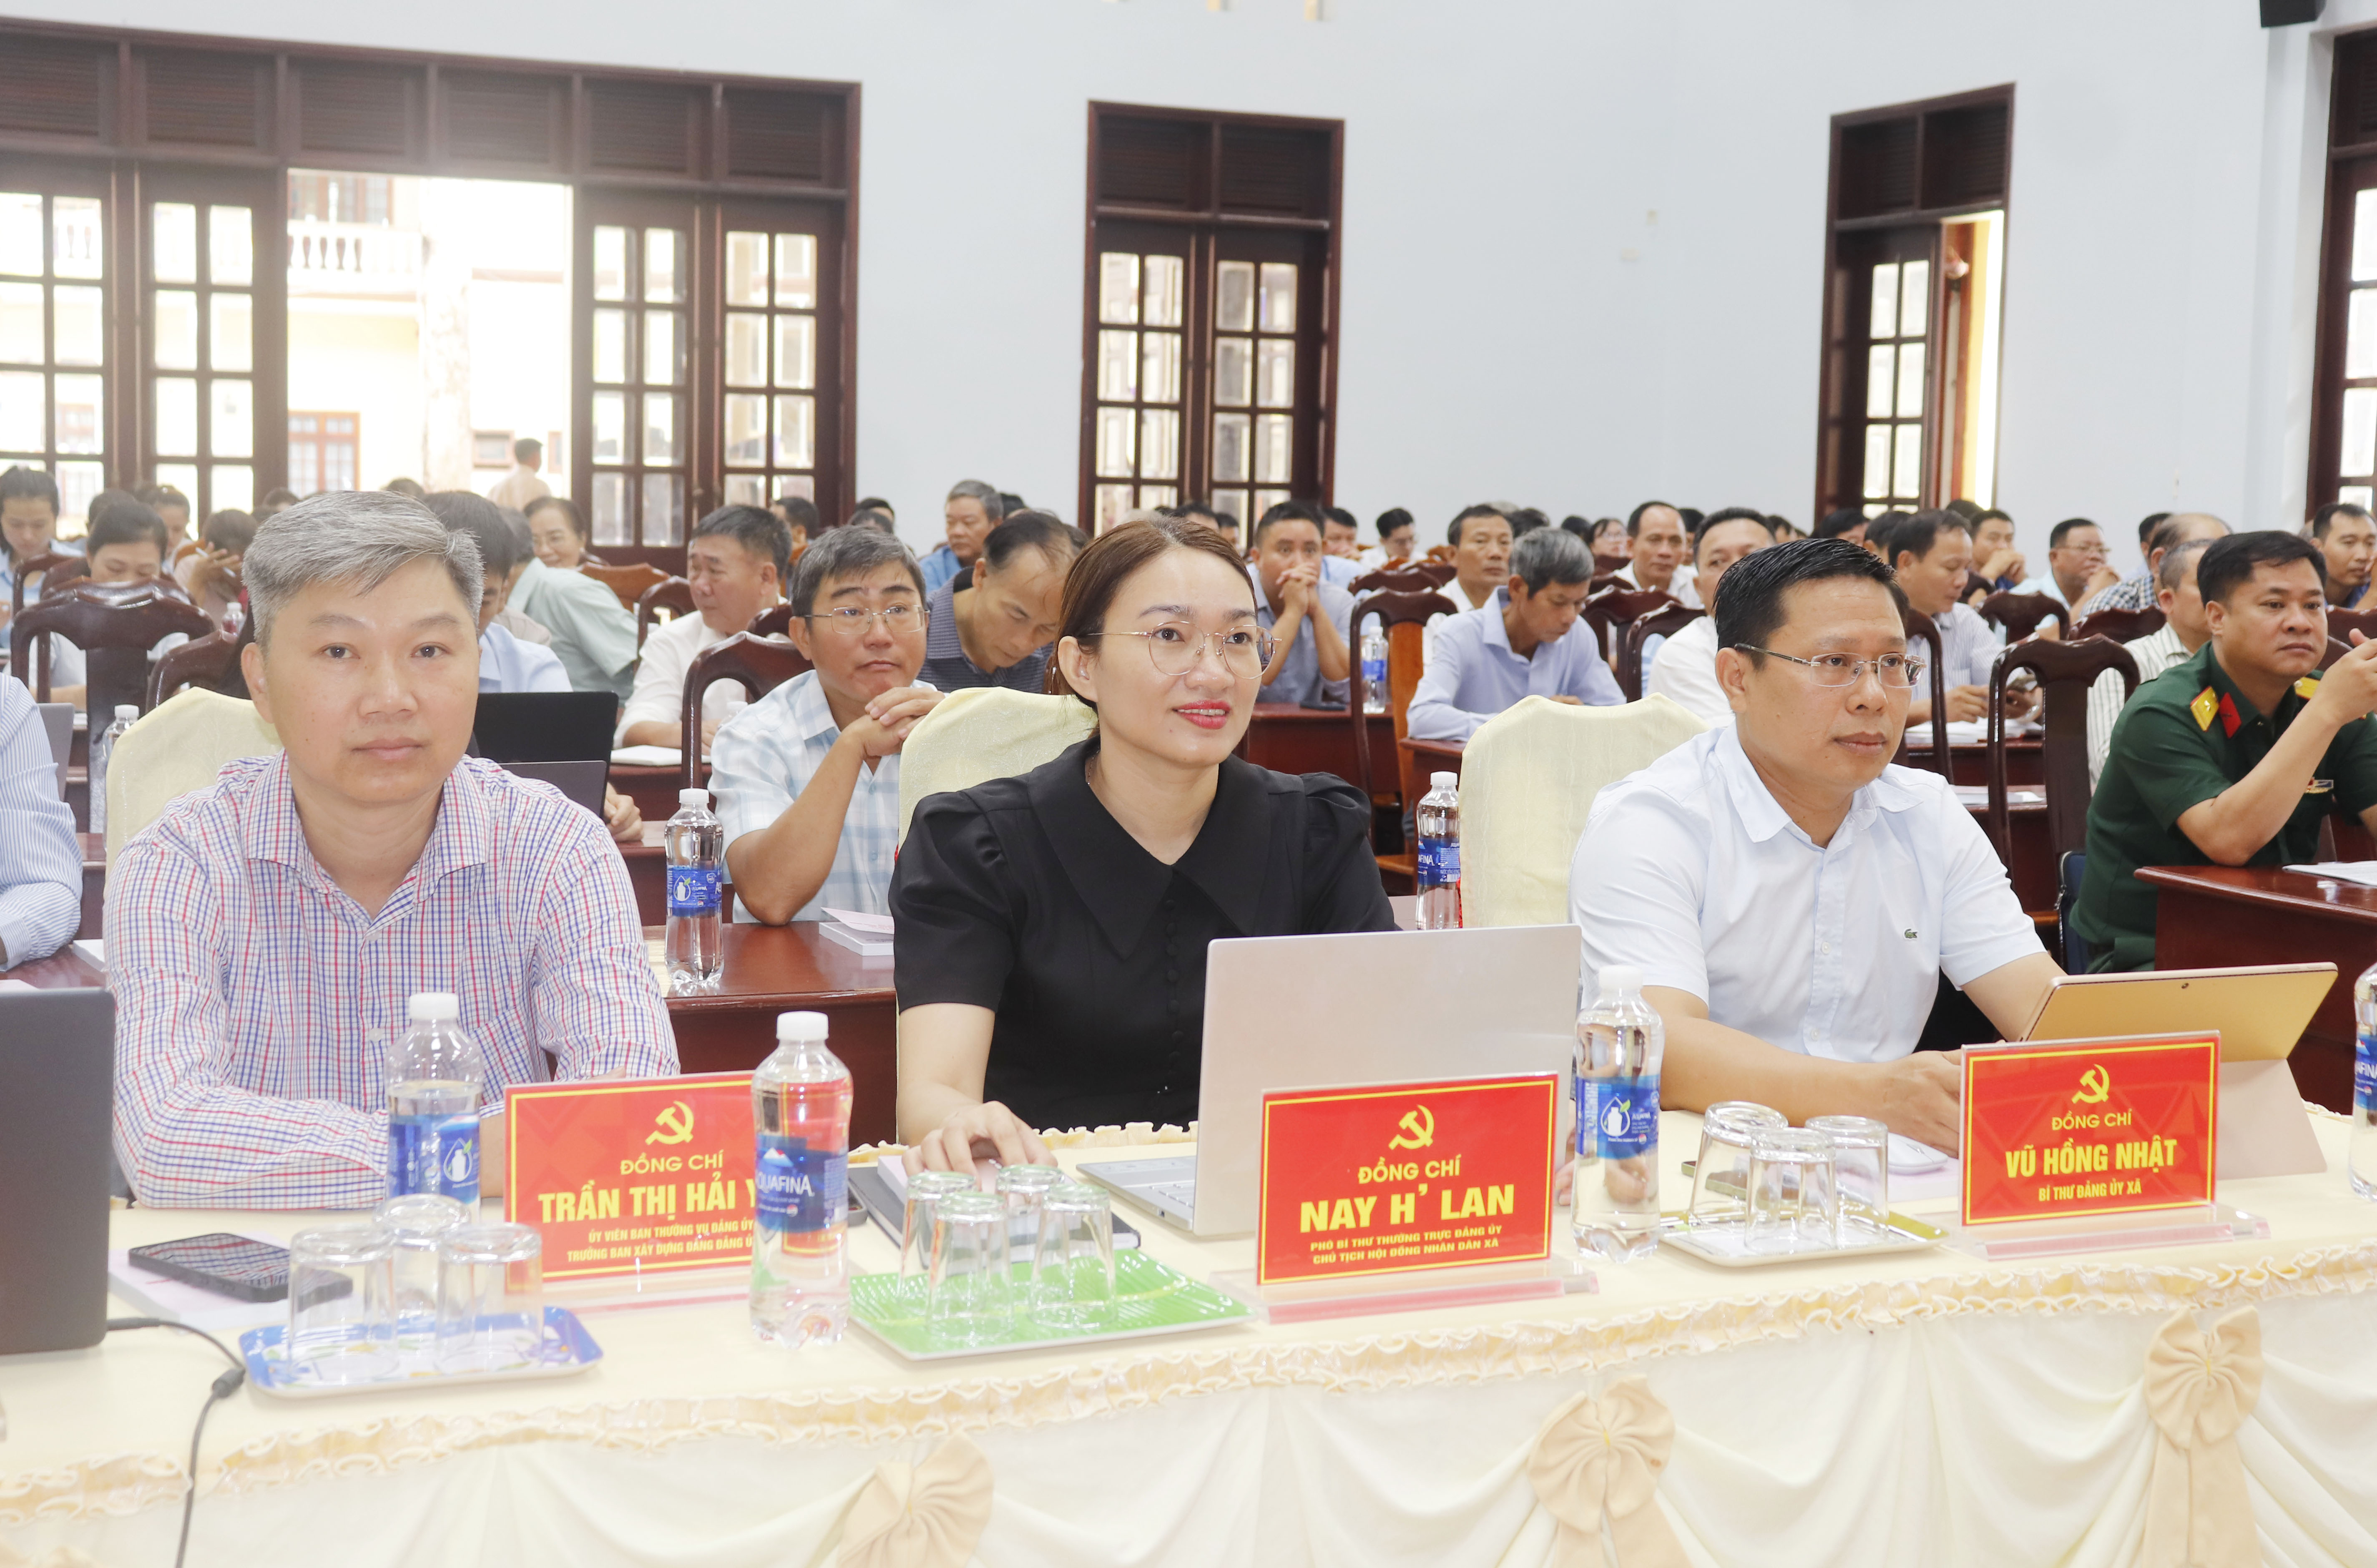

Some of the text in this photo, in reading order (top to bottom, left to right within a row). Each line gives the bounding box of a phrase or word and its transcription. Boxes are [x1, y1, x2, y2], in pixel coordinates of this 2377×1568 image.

[1418, 854, 1434, 866] AFINA
[2052, 1108, 2132, 1131] ĐỒNG CHÍ
[620, 1149, 724, 1175] ĐỒNG CHÍ
[2005, 1134, 2177, 1178] VŨ HỒNG NHẬT
[1358, 1153, 1461, 1184] ĐỒNG CHÍ
[757, 1171, 813, 1197] QUAFINA
[2039, 1178, 2142, 1201] BÍ THƯ ĐẢNG ỦY XÃ
[538, 1179, 620, 1223] TRẦN
[629, 1184, 676, 1221] THỊ
[686, 1171, 735, 1212] HẢI
[1300, 1195, 1377, 1233] NAY
[1441, 1184, 1514, 1220] LAN
[605, 1228, 628, 1241] VIÊN
[630, 1227, 652, 1240] BAN
[1337, 1237, 1349, 1249] BÍ
[1352, 1236, 1374, 1247] THƯ
[1424, 1229, 1451, 1241] TRỰC
[610, 1246, 632, 1259] BAN
[1339, 1251, 1364, 1263] TỊCH
[1368, 1248, 1387, 1260] HỘI
[1424, 1241, 1455, 1254] NHÂN
[1458, 1239, 1481, 1251] DÂN
